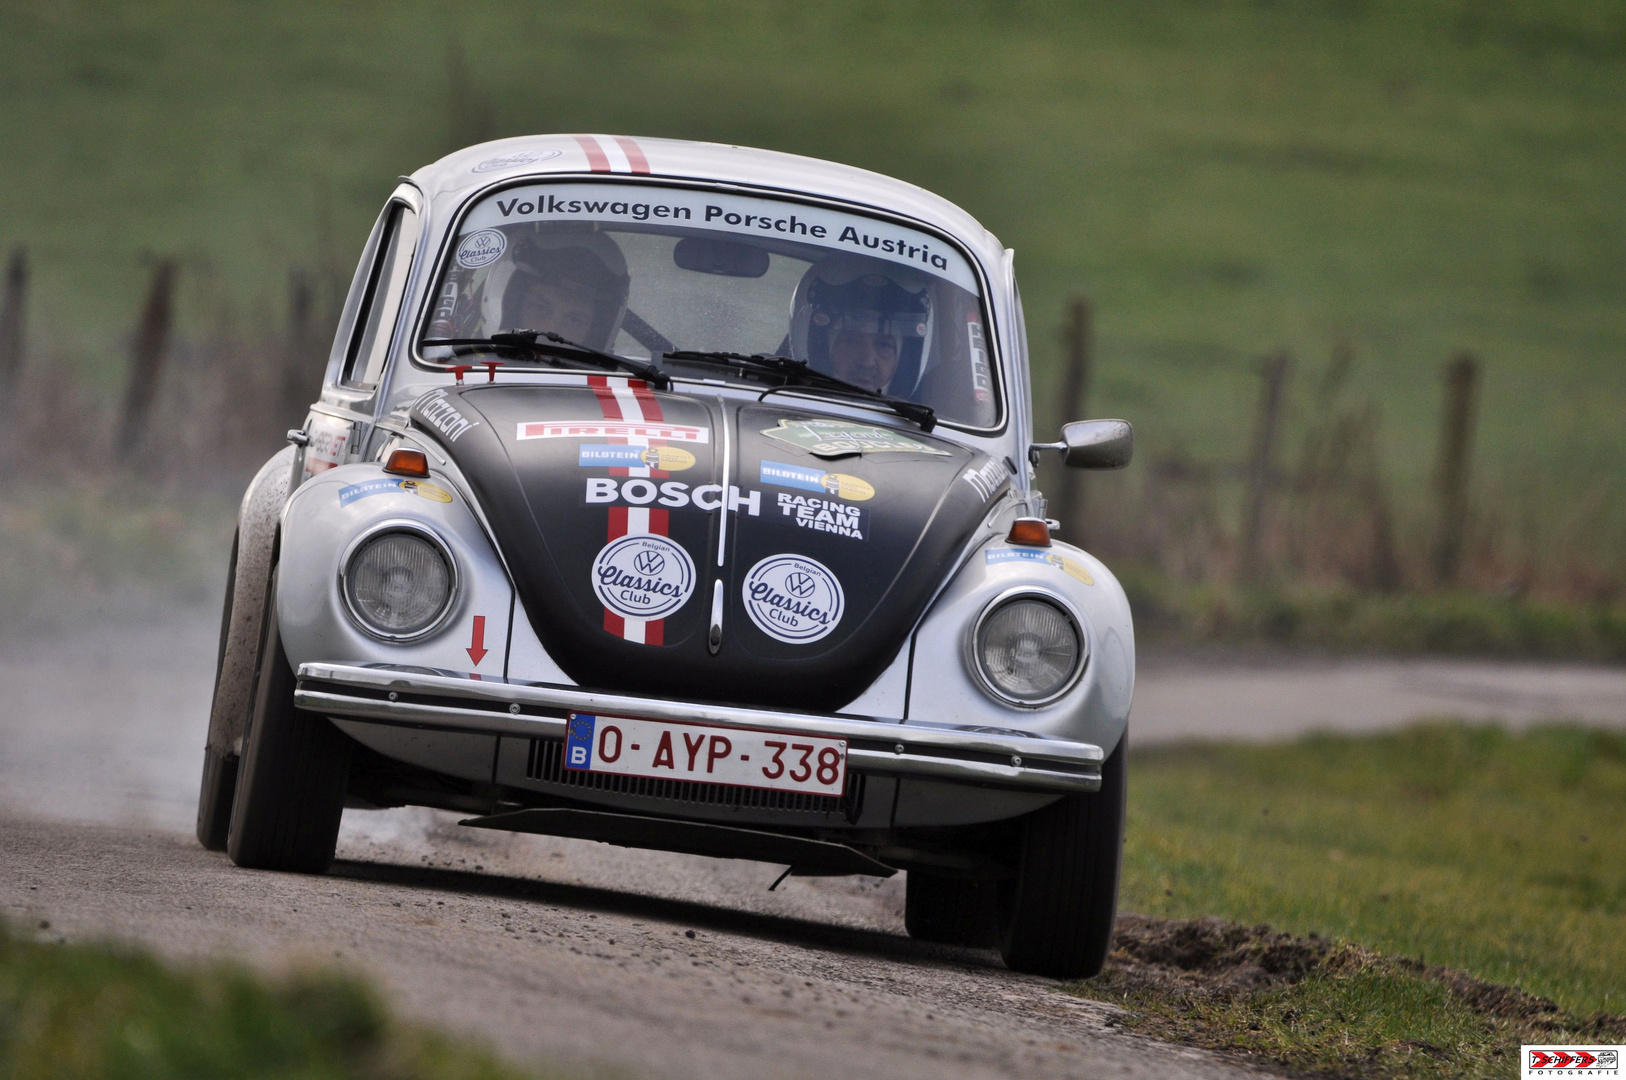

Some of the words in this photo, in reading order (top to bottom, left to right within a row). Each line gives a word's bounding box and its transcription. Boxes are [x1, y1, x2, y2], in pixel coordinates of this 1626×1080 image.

[497, 195, 691, 221] Volkswagen
[705, 205, 828, 238] Porsche
[838, 226, 948, 270] Austria
[459, 246, 502, 260] Classics
[525, 422, 700, 440] PIRELLI
[581, 450, 639, 459] BILSTEIN
[762, 467, 820, 483] BILSTEIN
[341, 481, 398, 499] BILSTEIN
[585, 477, 761, 517] BOSCH
[777, 492, 861, 517] RACING
[777, 502, 860, 529] TEAM
[795, 517, 863, 540] VIENNA
[641, 541, 671, 552] Belgian
[987, 551, 1045, 560] BILSTEIN
[793, 562, 822, 577] Belgian
[597, 565, 684, 598] Classics
[620, 590, 651, 605] Club
[749, 582, 831, 625] Classics
[769, 608, 799, 627] Club
[571, 746, 587, 764] B
